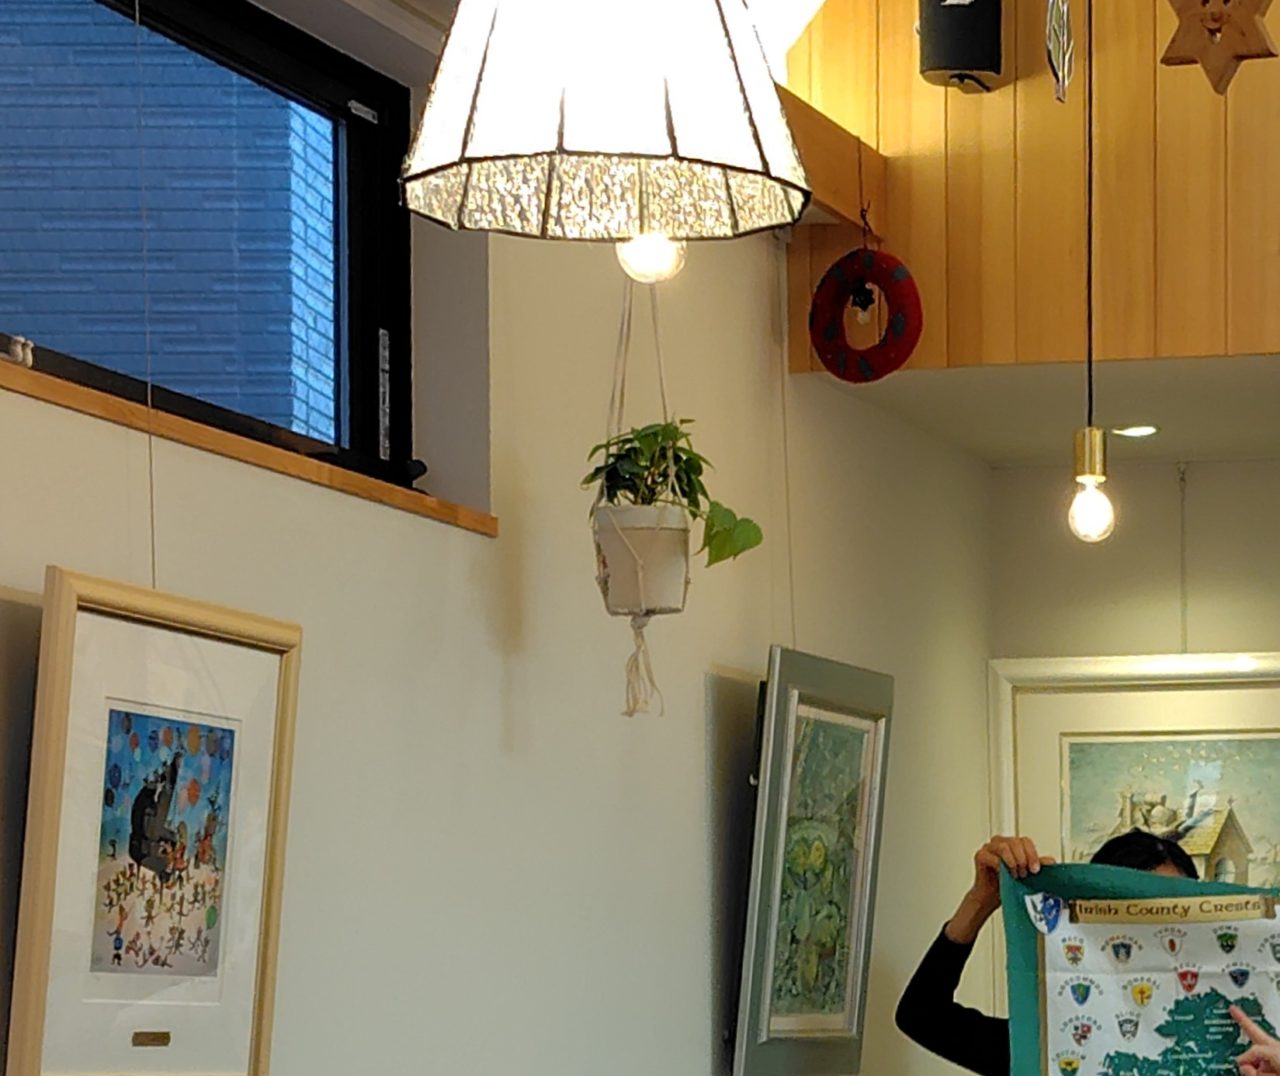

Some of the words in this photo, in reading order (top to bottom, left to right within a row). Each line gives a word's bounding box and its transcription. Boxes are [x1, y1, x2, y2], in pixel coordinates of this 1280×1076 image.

[1079, 903, 1119, 916] Irish
[1125, 903, 1191, 918] County
[1198, 900, 1262, 914] Crests
